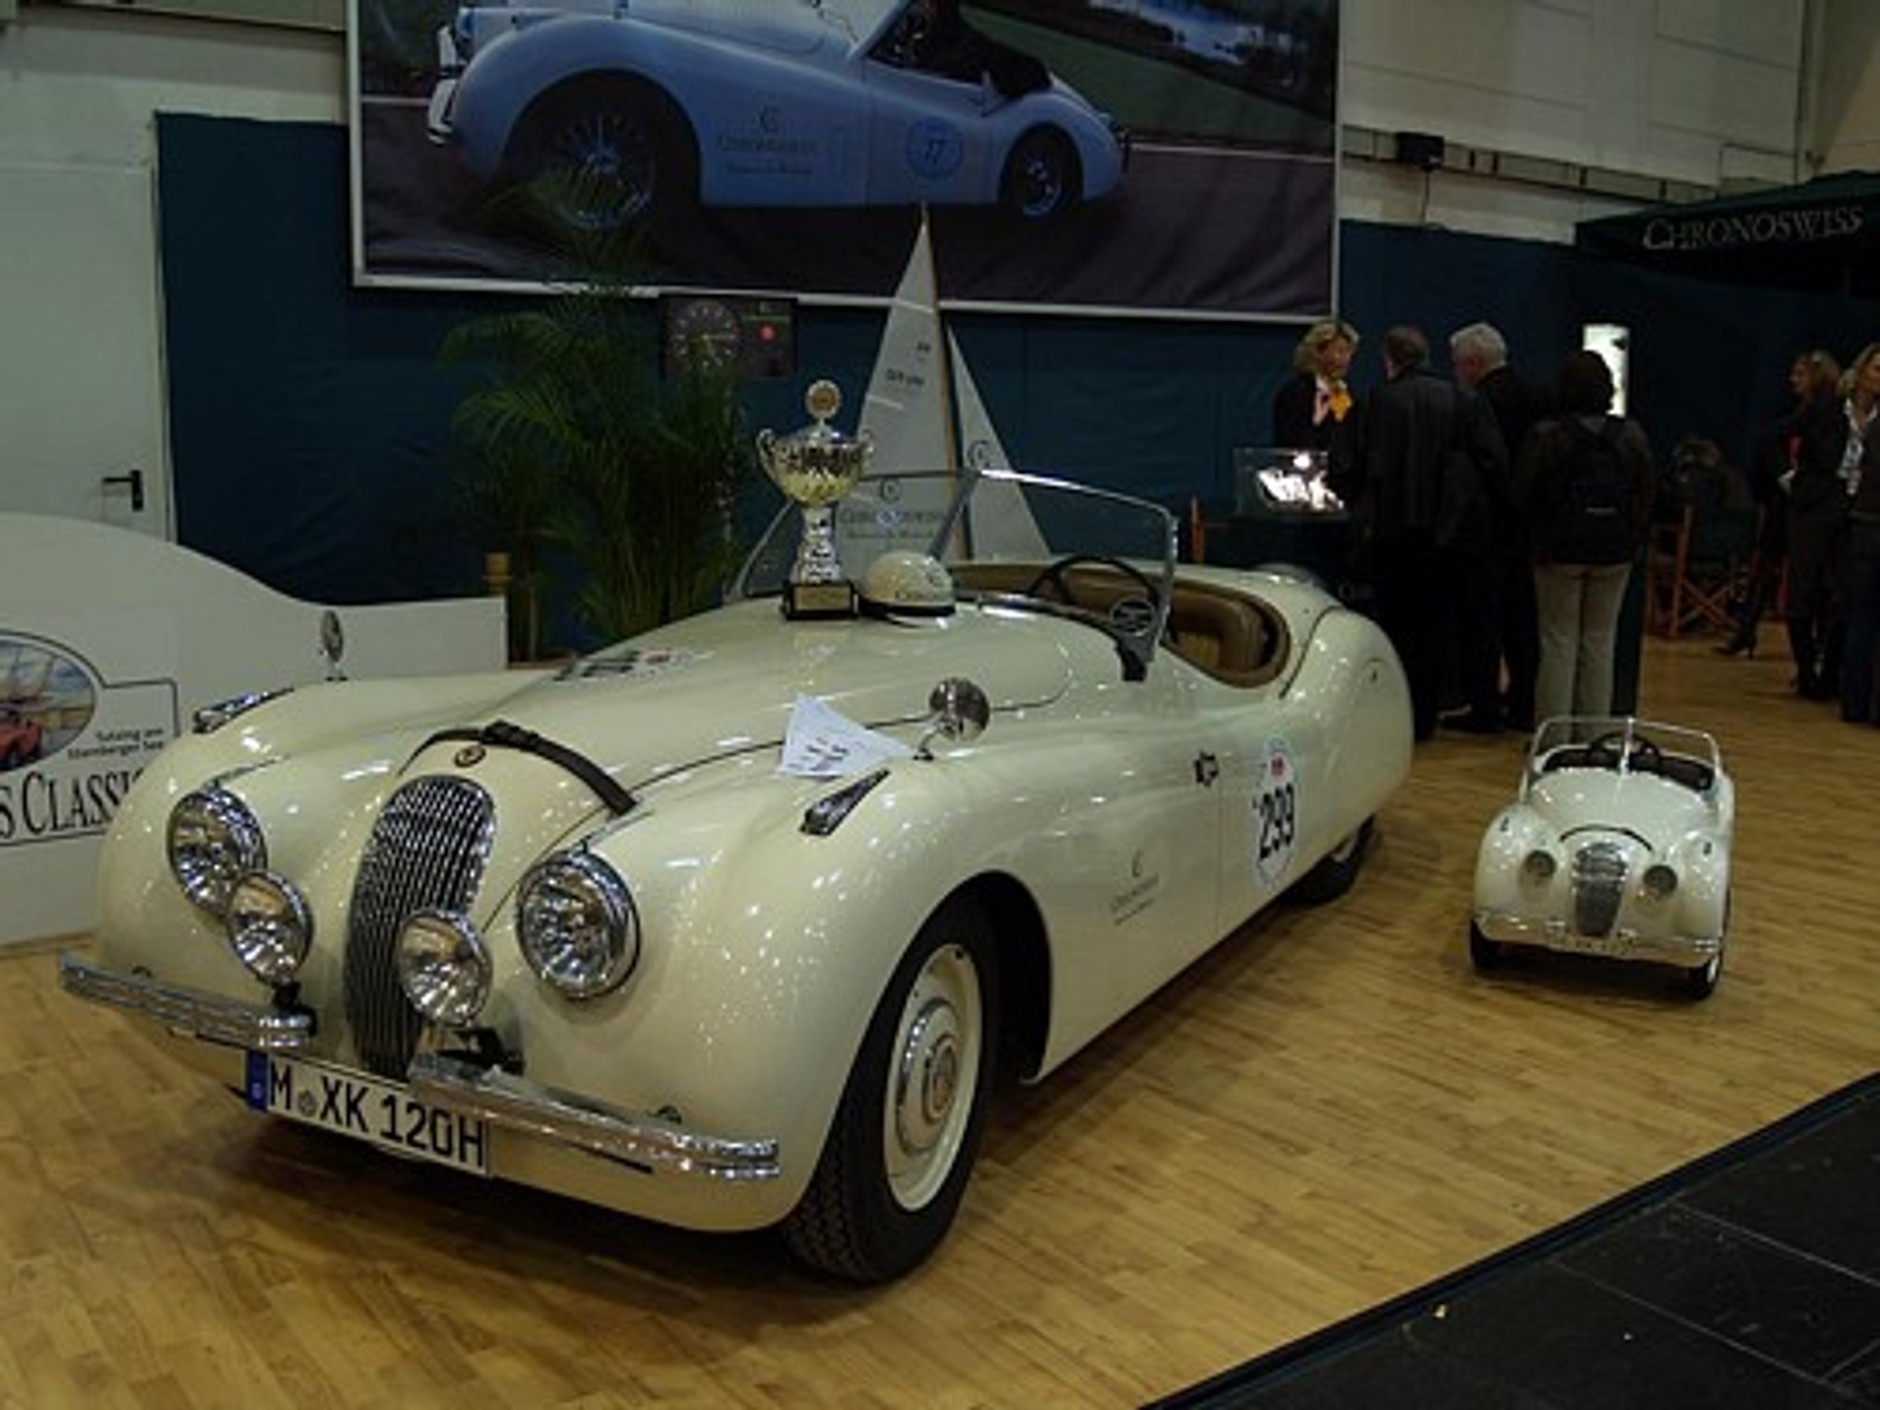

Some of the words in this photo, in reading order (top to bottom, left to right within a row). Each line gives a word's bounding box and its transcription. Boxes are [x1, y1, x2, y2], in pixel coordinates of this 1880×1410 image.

[1643, 207, 1864, 250] CHRONOSWISS
[270, 1061, 292, 1111] M
[320, 1075, 370, 1133] XK
[380, 1094, 484, 1168] 120H
